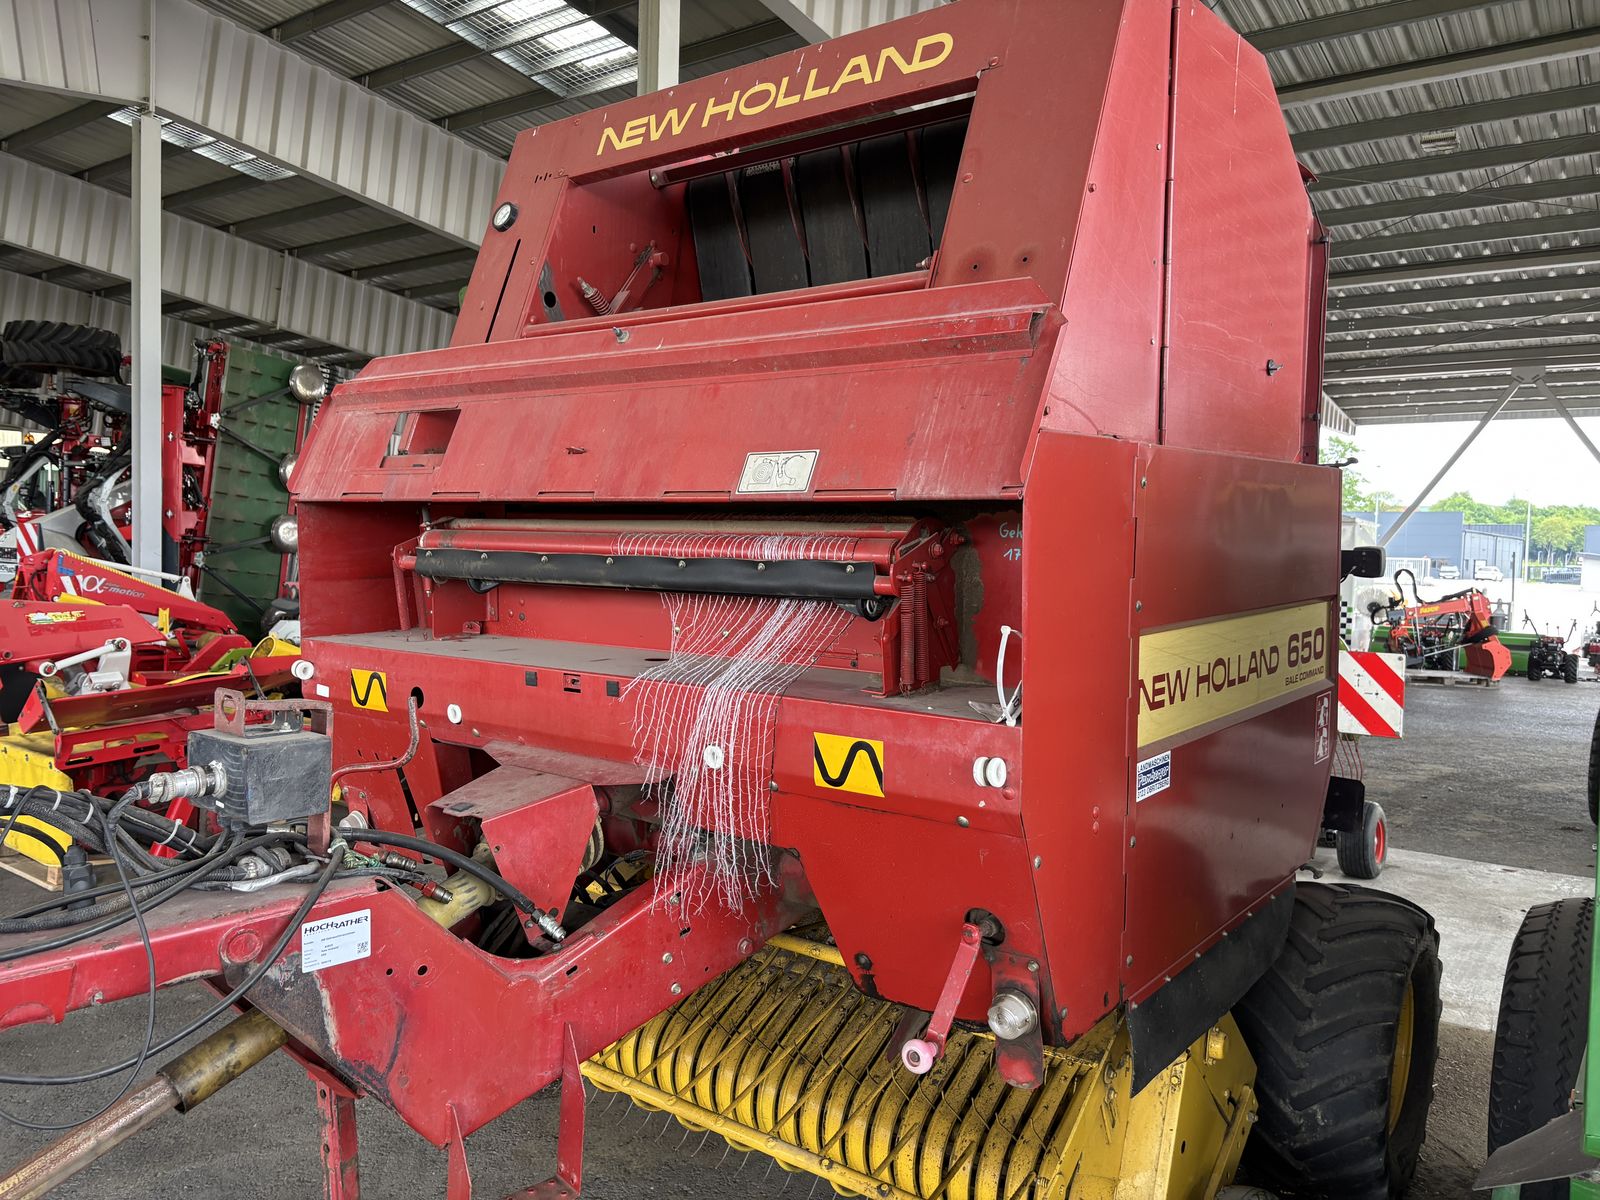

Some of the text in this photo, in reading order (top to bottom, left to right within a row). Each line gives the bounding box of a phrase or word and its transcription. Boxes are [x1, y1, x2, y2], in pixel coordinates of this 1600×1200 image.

[596, 32, 954, 156] NEW HOLLAND
[1138, 627, 1325, 711] NEW HOLLAND 650
[1285, 665, 1325, 686] BALE COMMAND
[304, 915, 369, 935] HOCHRATHER
